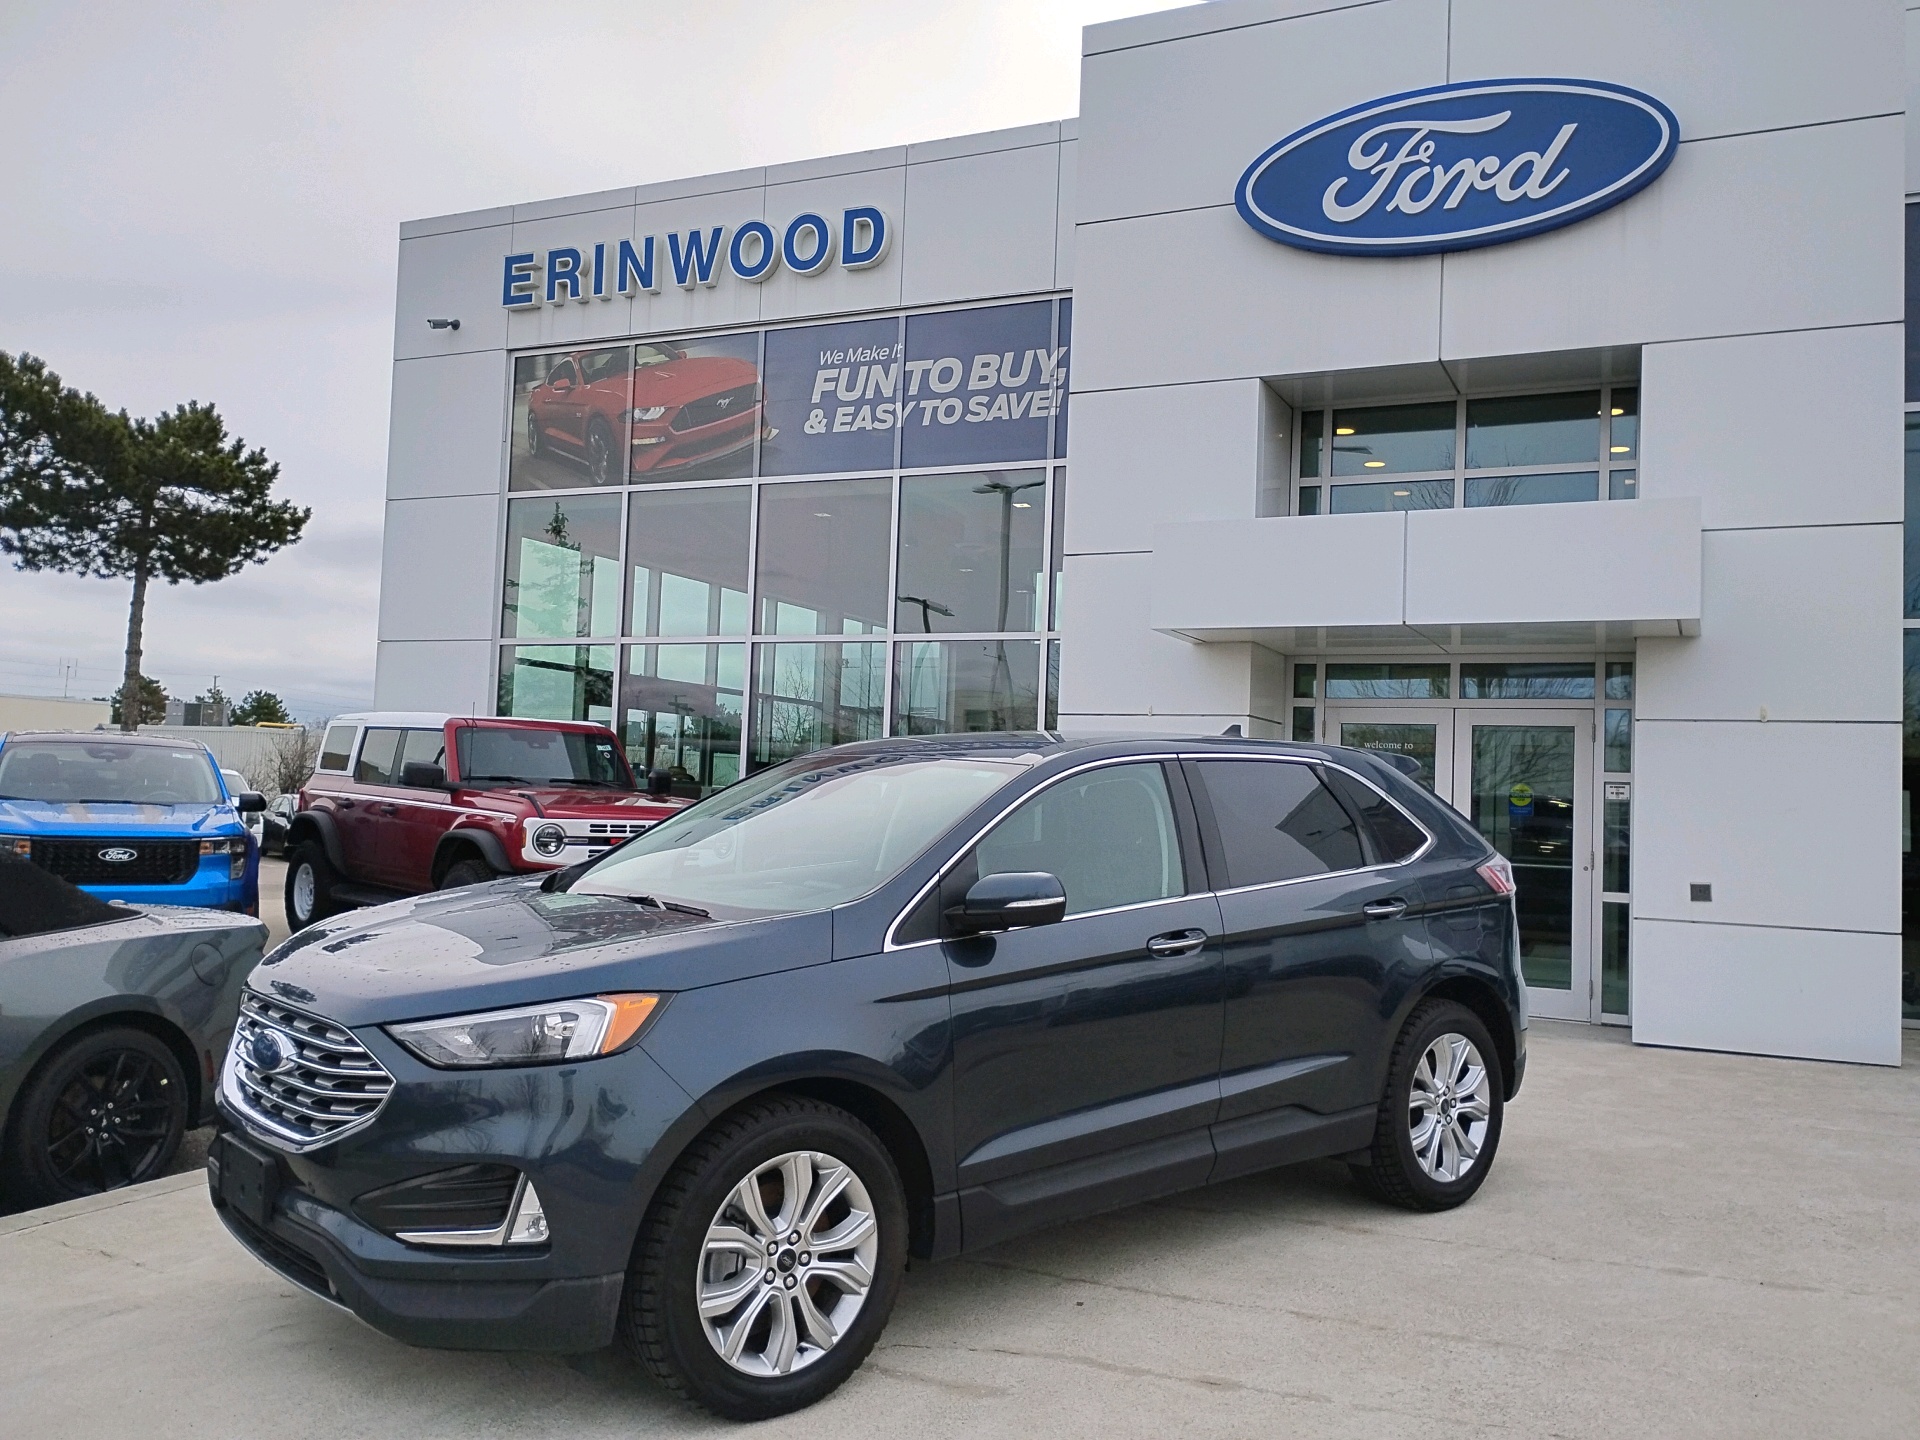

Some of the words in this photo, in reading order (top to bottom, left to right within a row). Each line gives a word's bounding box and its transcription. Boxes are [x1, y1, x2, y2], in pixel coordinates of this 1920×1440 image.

[1322, 110, 1578, 222] Ford
[502, 205, 890, 311] ERINWOOD
[820, 350, 844, 366] We
[845, 345, 890, 364] Make
[811, 363, 899, 404] FUN
[904, 357, 963, 396] TO
[803, 408, 828, 435] &
[832, 401, 917, 433] EASY
[919, 397, 963, 427] TO
[965, 388, 1064, 423] SAVE!
[1364, 740, 1402, 750] welcome
[1404, 742, 1414, 750] to
[105, 850, 130, 860] Ford
